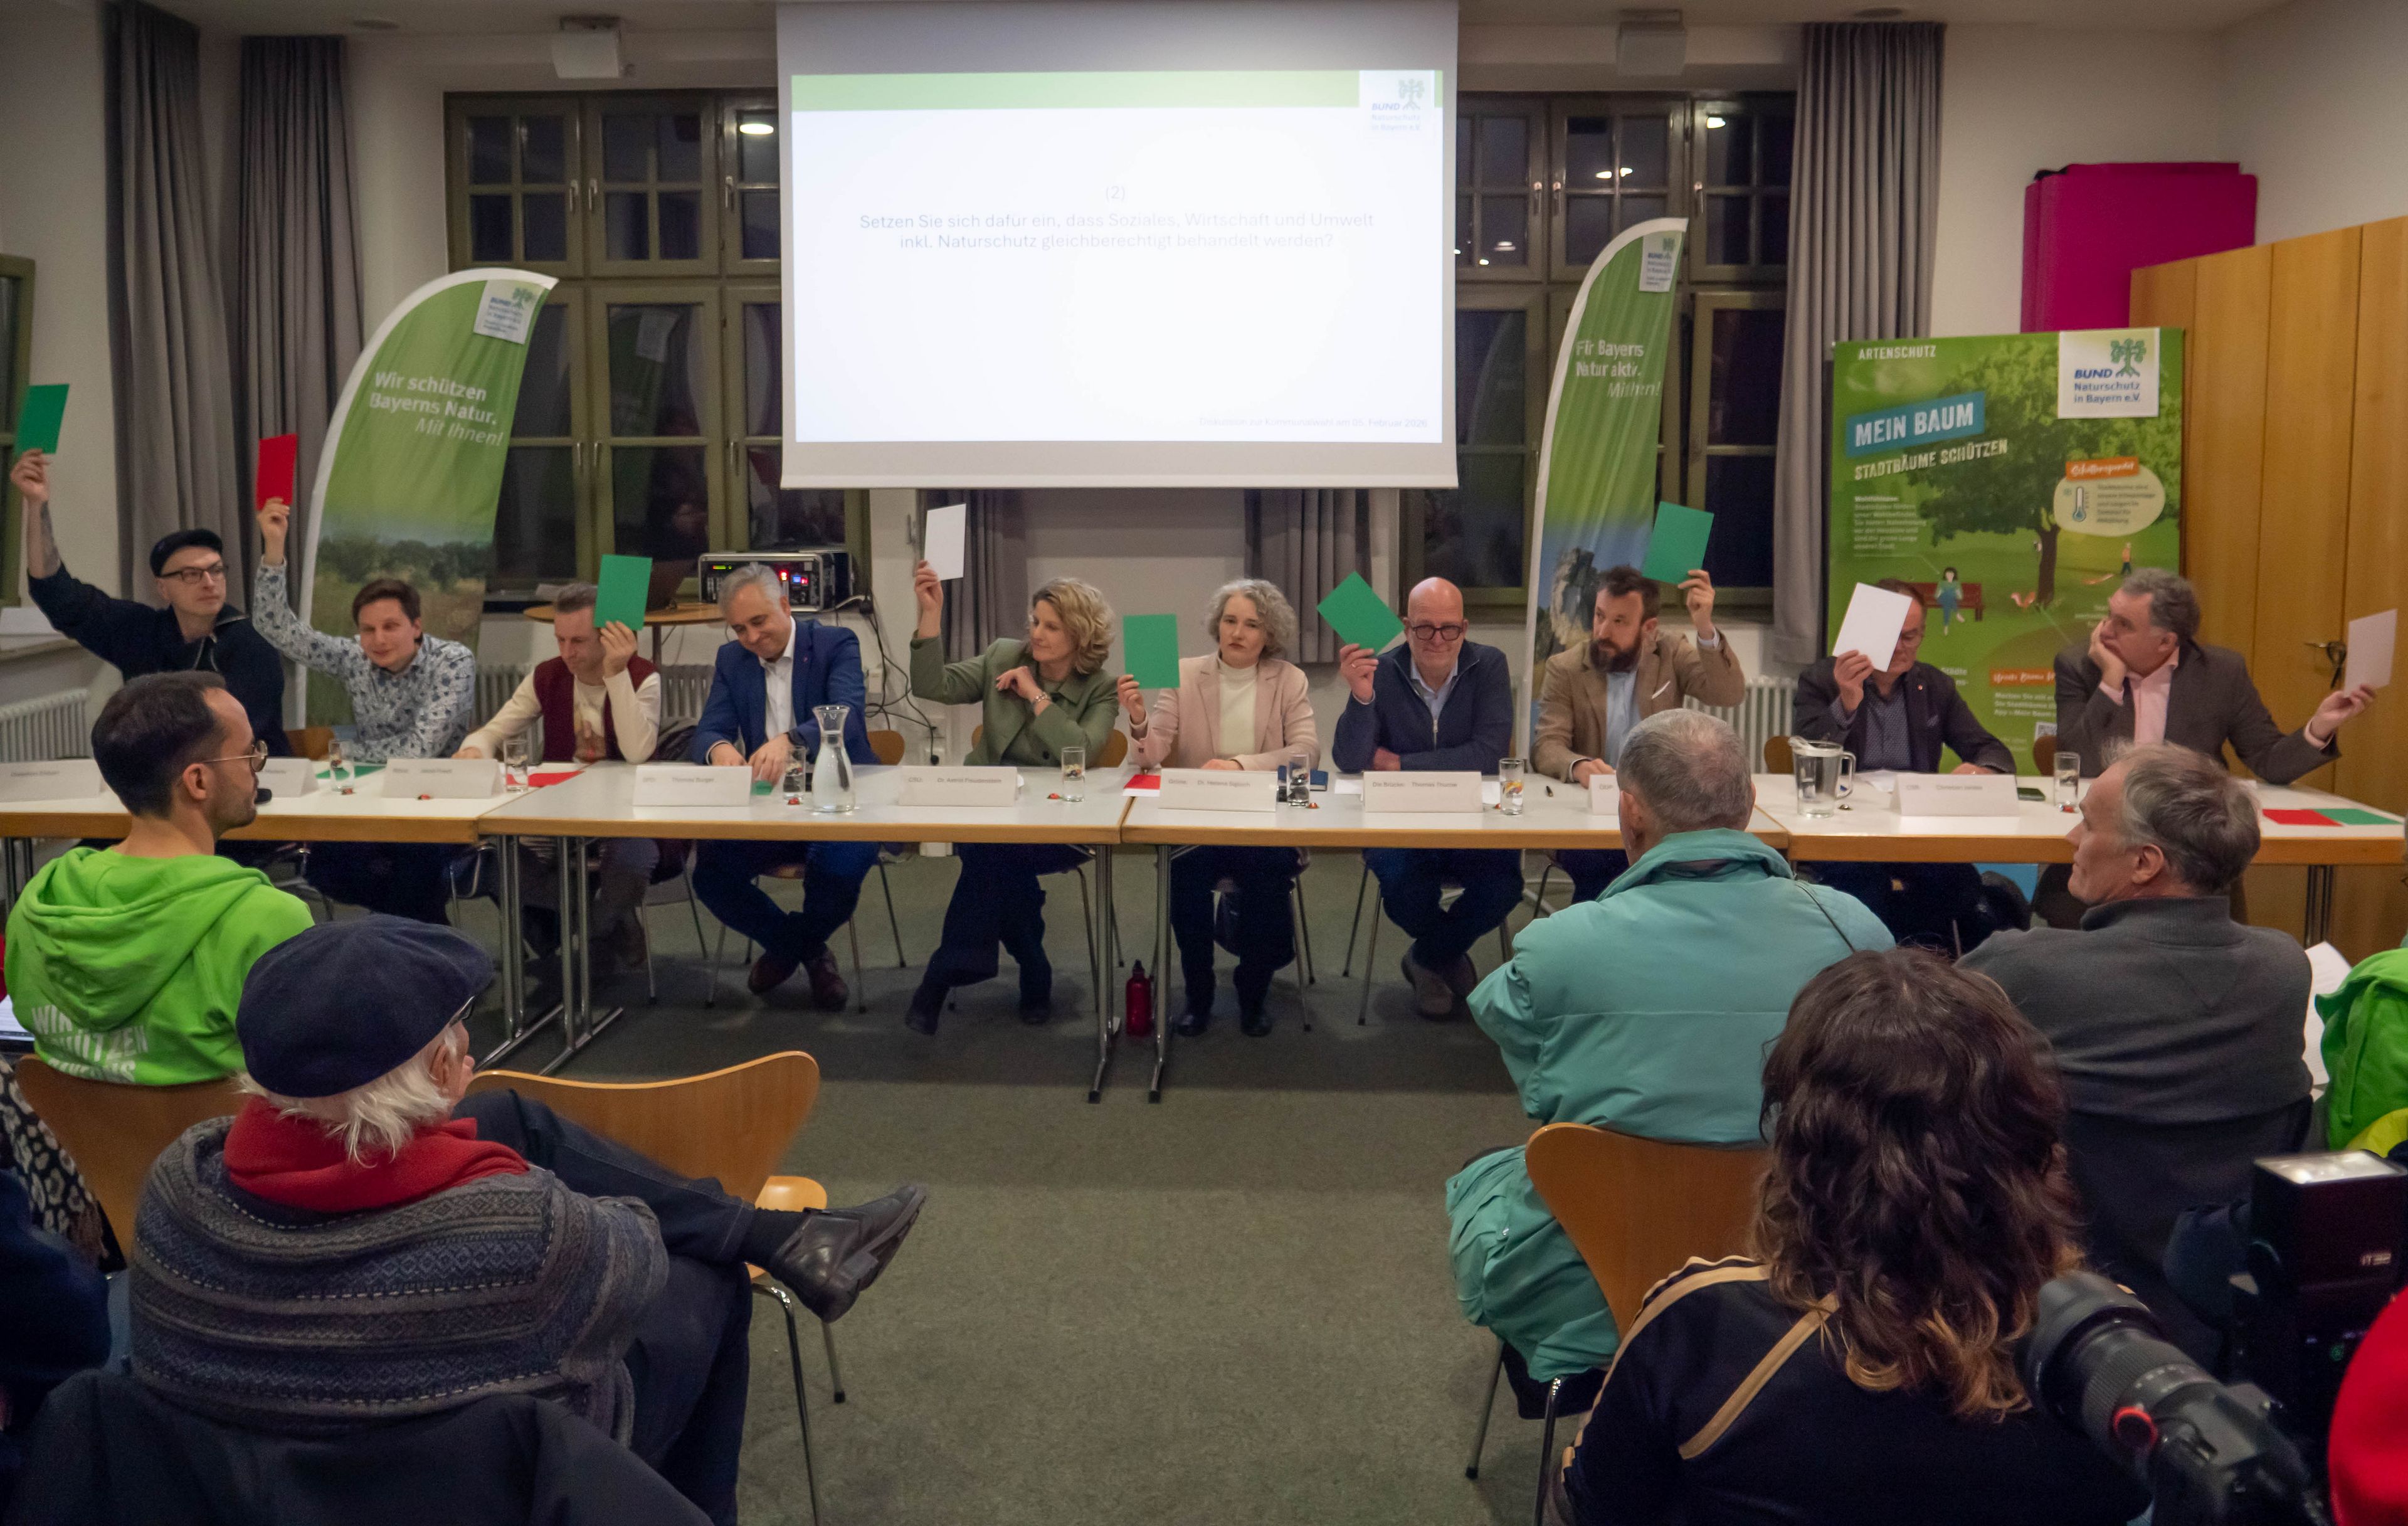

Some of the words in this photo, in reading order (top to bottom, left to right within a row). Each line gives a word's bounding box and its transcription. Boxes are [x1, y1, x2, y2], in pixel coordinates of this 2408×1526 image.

[1371, 103, 1400, 111] BUND
[1105, 185, 1126, 202] (2)
[860, 214, 914, 228] Setzen
[919, 214, 943, 228] Sie
[948, 213, 980, 228] sich
[1032, 214, 1062, 229] ein,
[1066, 213, 1104, 227] dass
[1108, 212, 1181, 228] Soziales,
[1184, 211, 1270, 227] Wirtschaft
[1275, 212, 1306, 227] und
[1310, 211, 1375, 227] Umwelt
[899, 234, 933, 249] inkl.
[938, 235, 1037, 249] Naturschutz
[1041, 234, 1172, 251] gleichberechtigt
[1177, 233, 1259, 248] behandelt
[1264, 233, 1334, 248] werden?
[1858, 344, 1937, 361] ARTENSCHUTZ
[2074, 368, 2113, 379] BUND
[375, 371, 404, 389] Wir
[407, 376, 487, 402] schützen
[2074, 381, 2141, 392] Naturschutz
[2074, 394, 2084, 403] in
[2086, 393, 2122, 405] Bayern
[369, 392, 440, 414] Bayerns
[445, 400, 497, 426] Natur.
[1368, 418, 1402, 427] Februar
[1855, 415, 1907, 448] MEIN
[1914, 401, 1975, 436] BAUM
[415, 418, 445, 436] Mit
[447, 423, 504, 446] Ihnen!
[1854, 452, 1937, 481] STADTBÄUME
[1940, 438, 2008, 465] SCHÜTZEN
[31, 1005, 73, 1034] WIR
